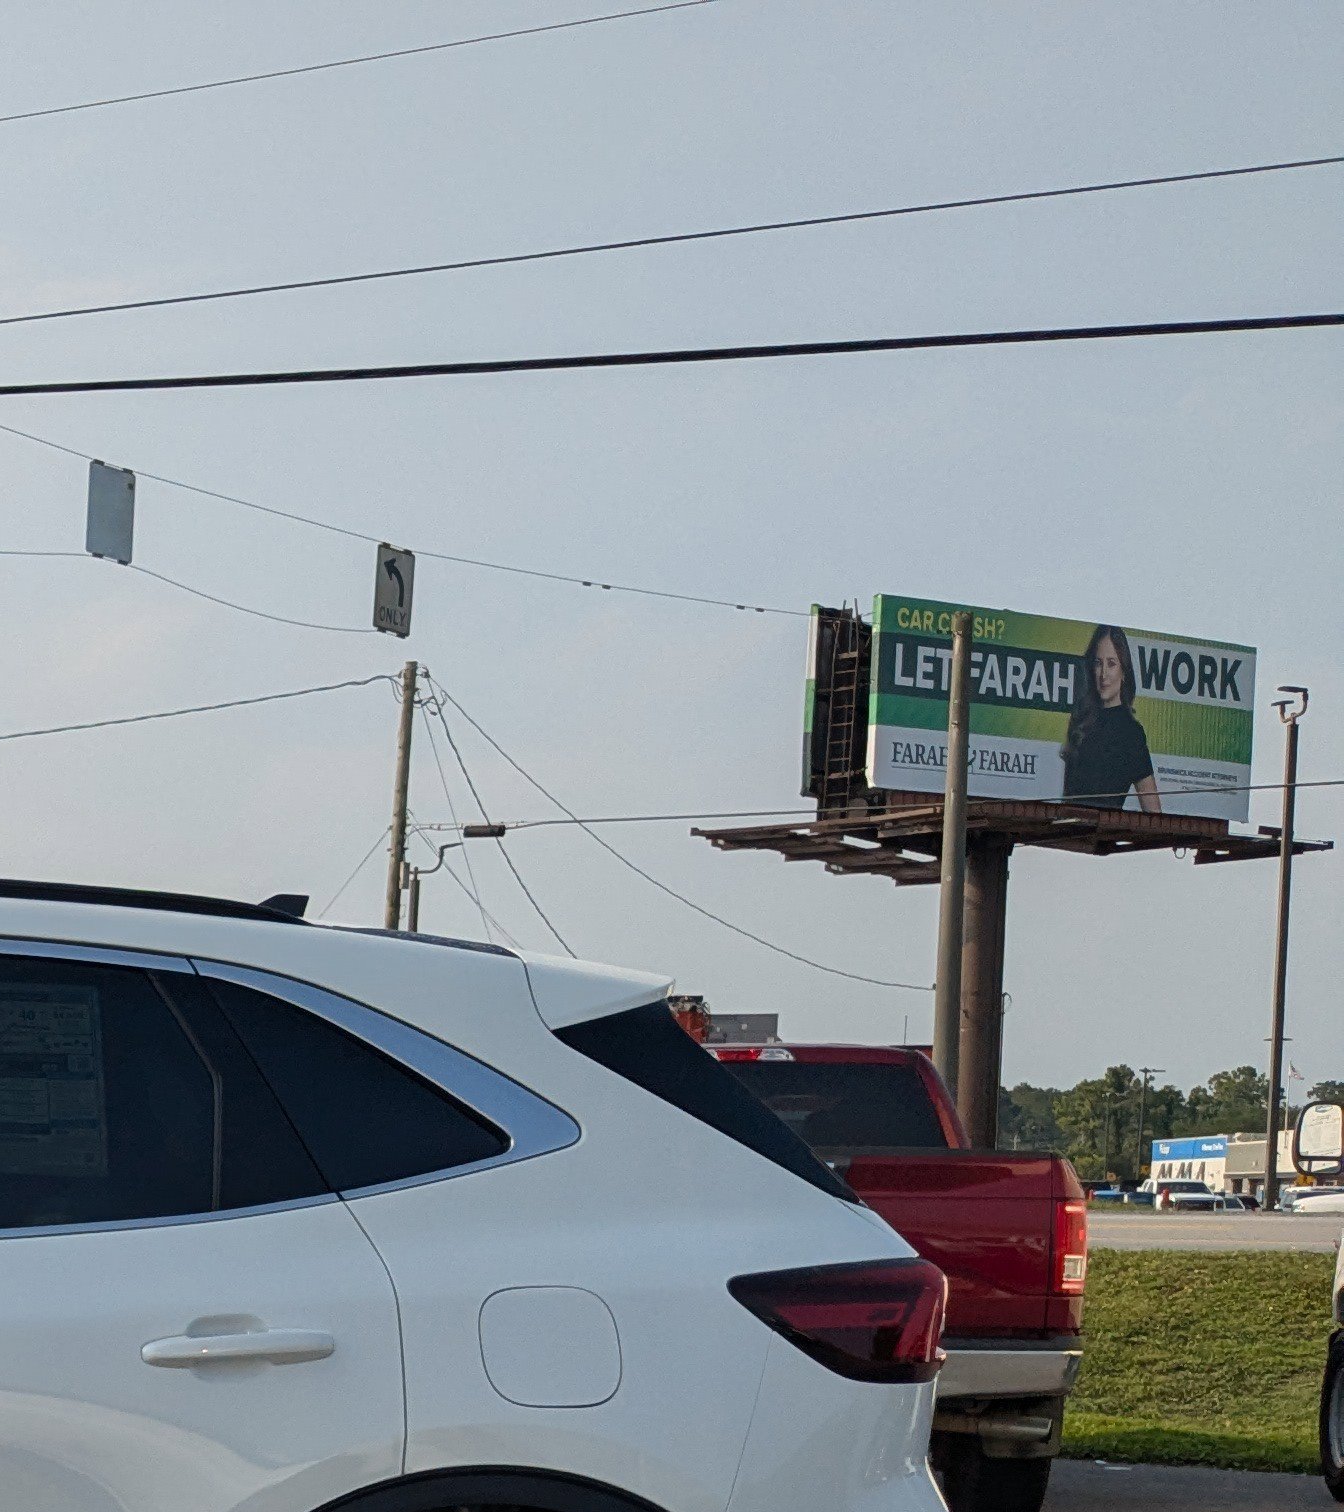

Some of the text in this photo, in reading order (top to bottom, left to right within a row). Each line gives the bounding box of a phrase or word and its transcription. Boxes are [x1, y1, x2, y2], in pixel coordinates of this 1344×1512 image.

[379, 606, 406, 626] ONLY
[897, 608, 1006, 640] CAR CSH?
[894, 643, 953, 691] LET
[1137, 645, 1242, 701] WORK
[978, 750, 1036, 774] FARAH
